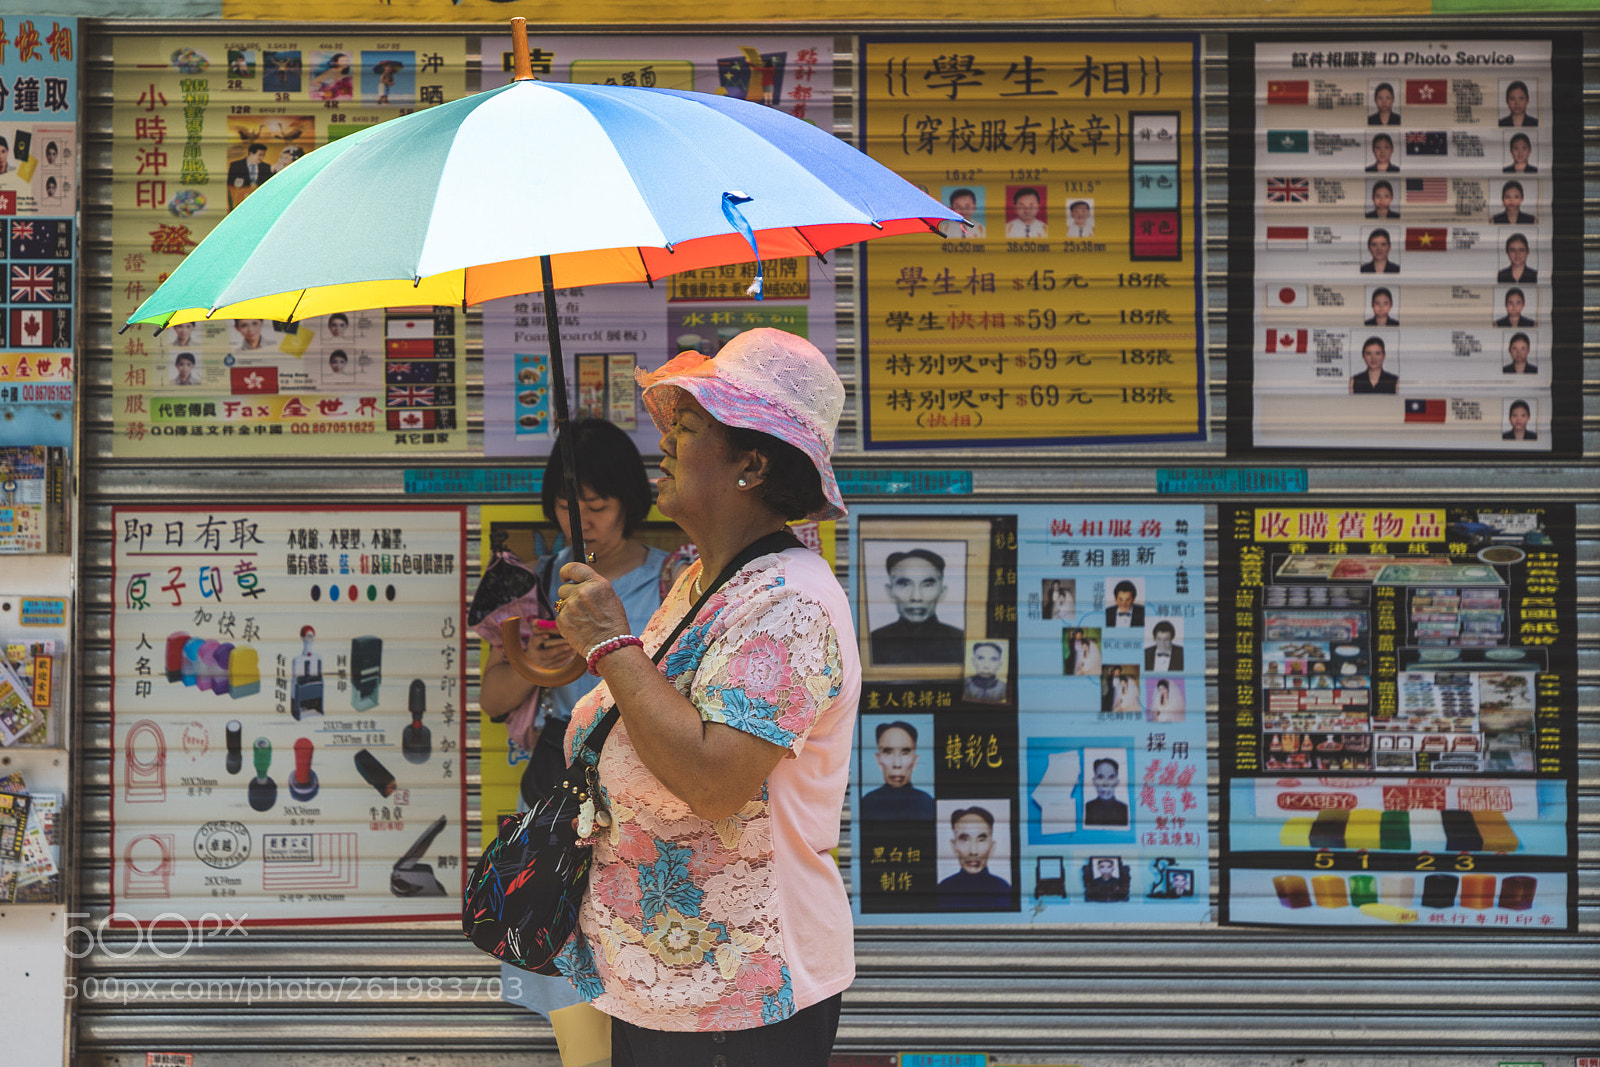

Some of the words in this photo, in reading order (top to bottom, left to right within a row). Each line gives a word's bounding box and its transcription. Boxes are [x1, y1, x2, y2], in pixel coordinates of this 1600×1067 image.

[1382, 51, 1399, 65] ID
[1403, 51, 1451, 65] Photo
[1455, 51, 1515, 66] Service
[227, 80, 242, 89] 2R
[275, 93, 290, 102] 3R
[324, 101, 339, 109] 4R
[230, 105, 251, 114] 12R
[331, 113, 346, 123] 8R
[135, 63, 169, 209] 一小時沖印
[896, 266, 996, 298] 學生相
[682, 312, 795, 327] 水杯系列
[885, 311, 1006, 332] 學生快相
[885, 353, 1009, 376] 特別呎吋
[223, 401, 270, 418] Fax
[281, 397, 384, 418] 全世界
[885, 388, 1009, 411] 特別呎吋
[124, 515, 264, 551] 即日有取
[1051, 519, 1162, 538] 執相服務
[1260, 510, 1441, 540] 收購舊物品
[1061, 546, 1156, 567] 舊相翻新
[126, 559, 266, 611] 原子印章
[135, 632, 152, 698] 人名印
[945, 733, 1003, 769] 轉彩色
[1315, 854, 1335, 869] 5
[1357, 855, 1370, 869] 1
[1416, 856, 1436, 871] 2
[1455, 856, 1475, 871] 3
